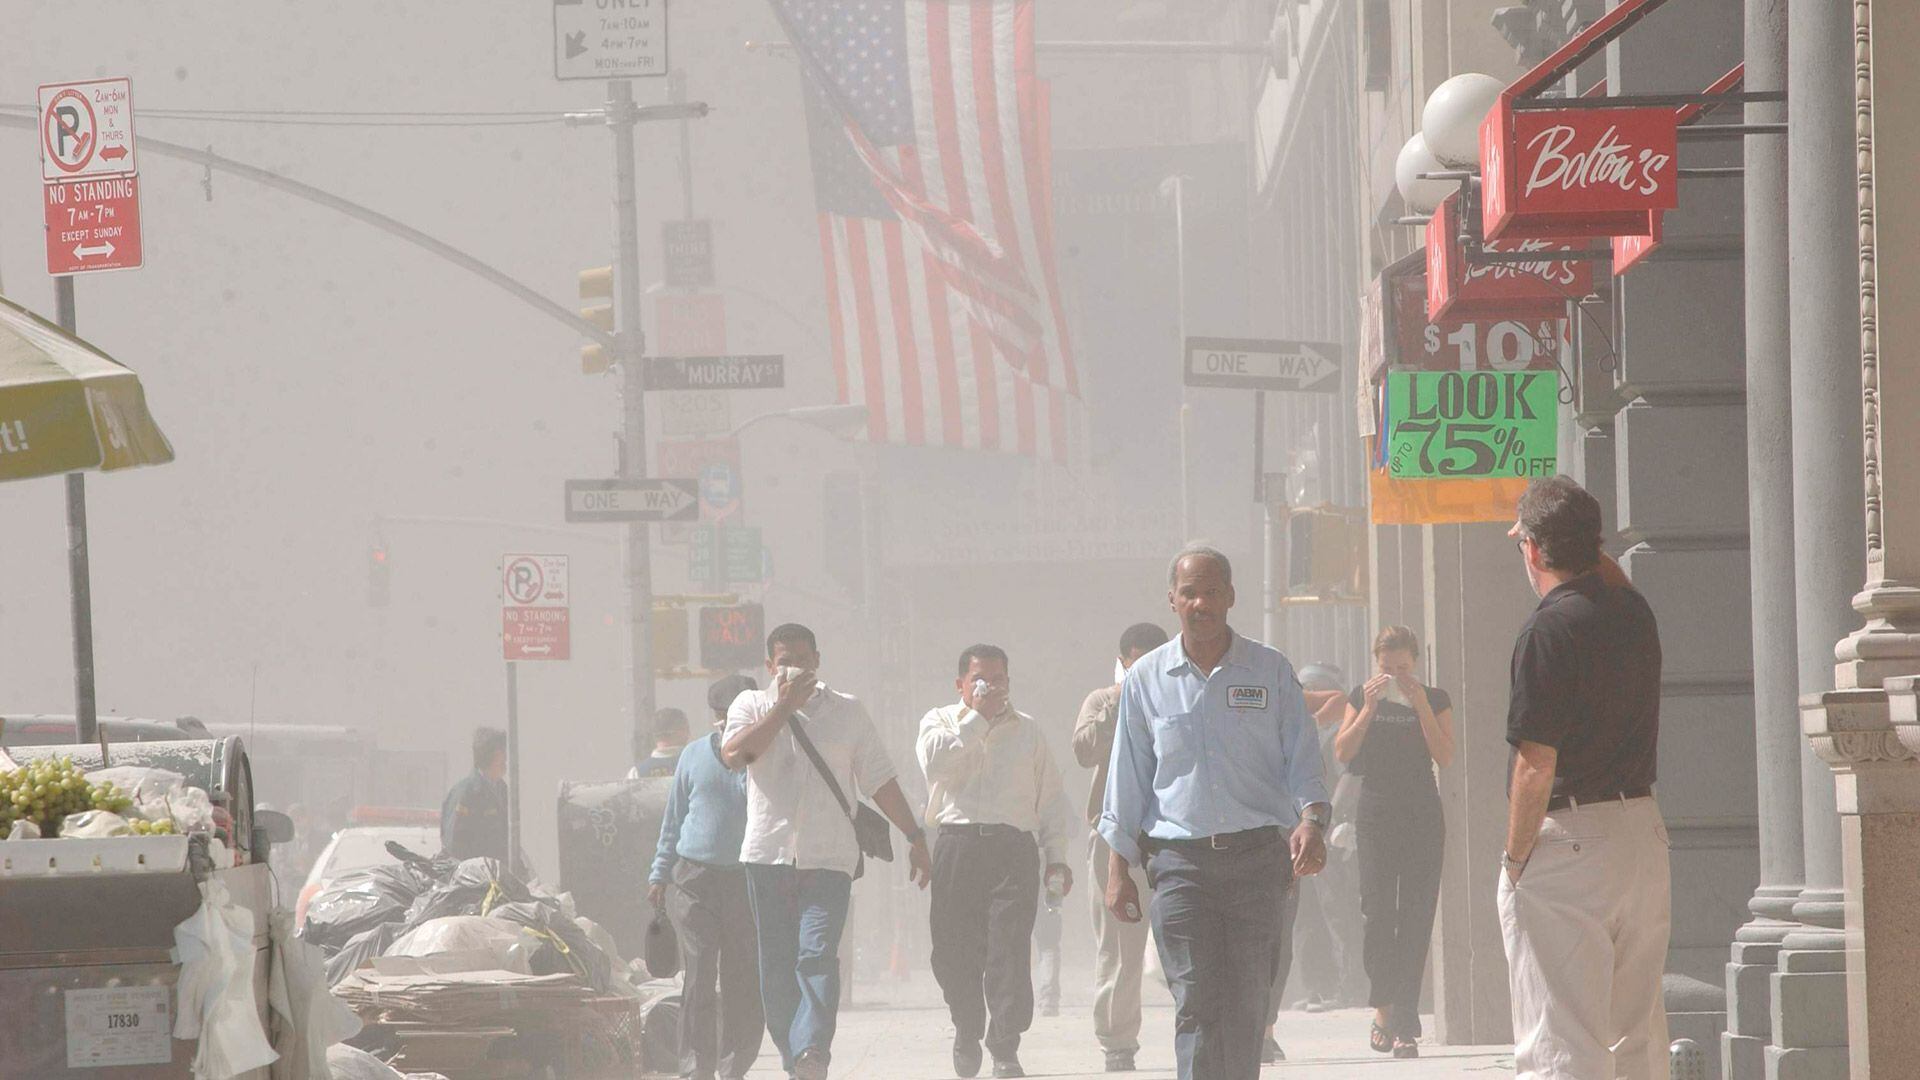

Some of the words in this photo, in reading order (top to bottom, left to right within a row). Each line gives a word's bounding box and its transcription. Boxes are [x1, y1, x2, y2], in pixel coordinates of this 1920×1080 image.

[95, 89, 126, 103] 2AM-6AM
[104, 105, 119, 115] MON
[108, 118, 114, 127] &
[101, 131, 124, 141] THURS
[1525, 124, 1670, 198] Bolton's
[49, 185, 66, 205] NO
[74, 179, 133, 202] STANDING
[61, 229, 89, 242] EXCEPT
[94, 226, 123, 239] SUNDAY
[1206, 353, 1248, 374] ONE
[1279, 356, 1323, 377] WAY
[688, 364, 764, 384] MURRAY
[766, 364, 780, 375] ST
[1408, 372, 1537, 420] LOOK
[1392, 419, 1525, 476] 75%
[1514, 457, 1556, 477] OFF
[583, 493, 619, 509] ONE
[644, 492, 683, 508] WAY
[505, 610, 518, 622] NO
[523, 610, 566, 623] STANDING
[108, 1013, 140, 1029] 17830
